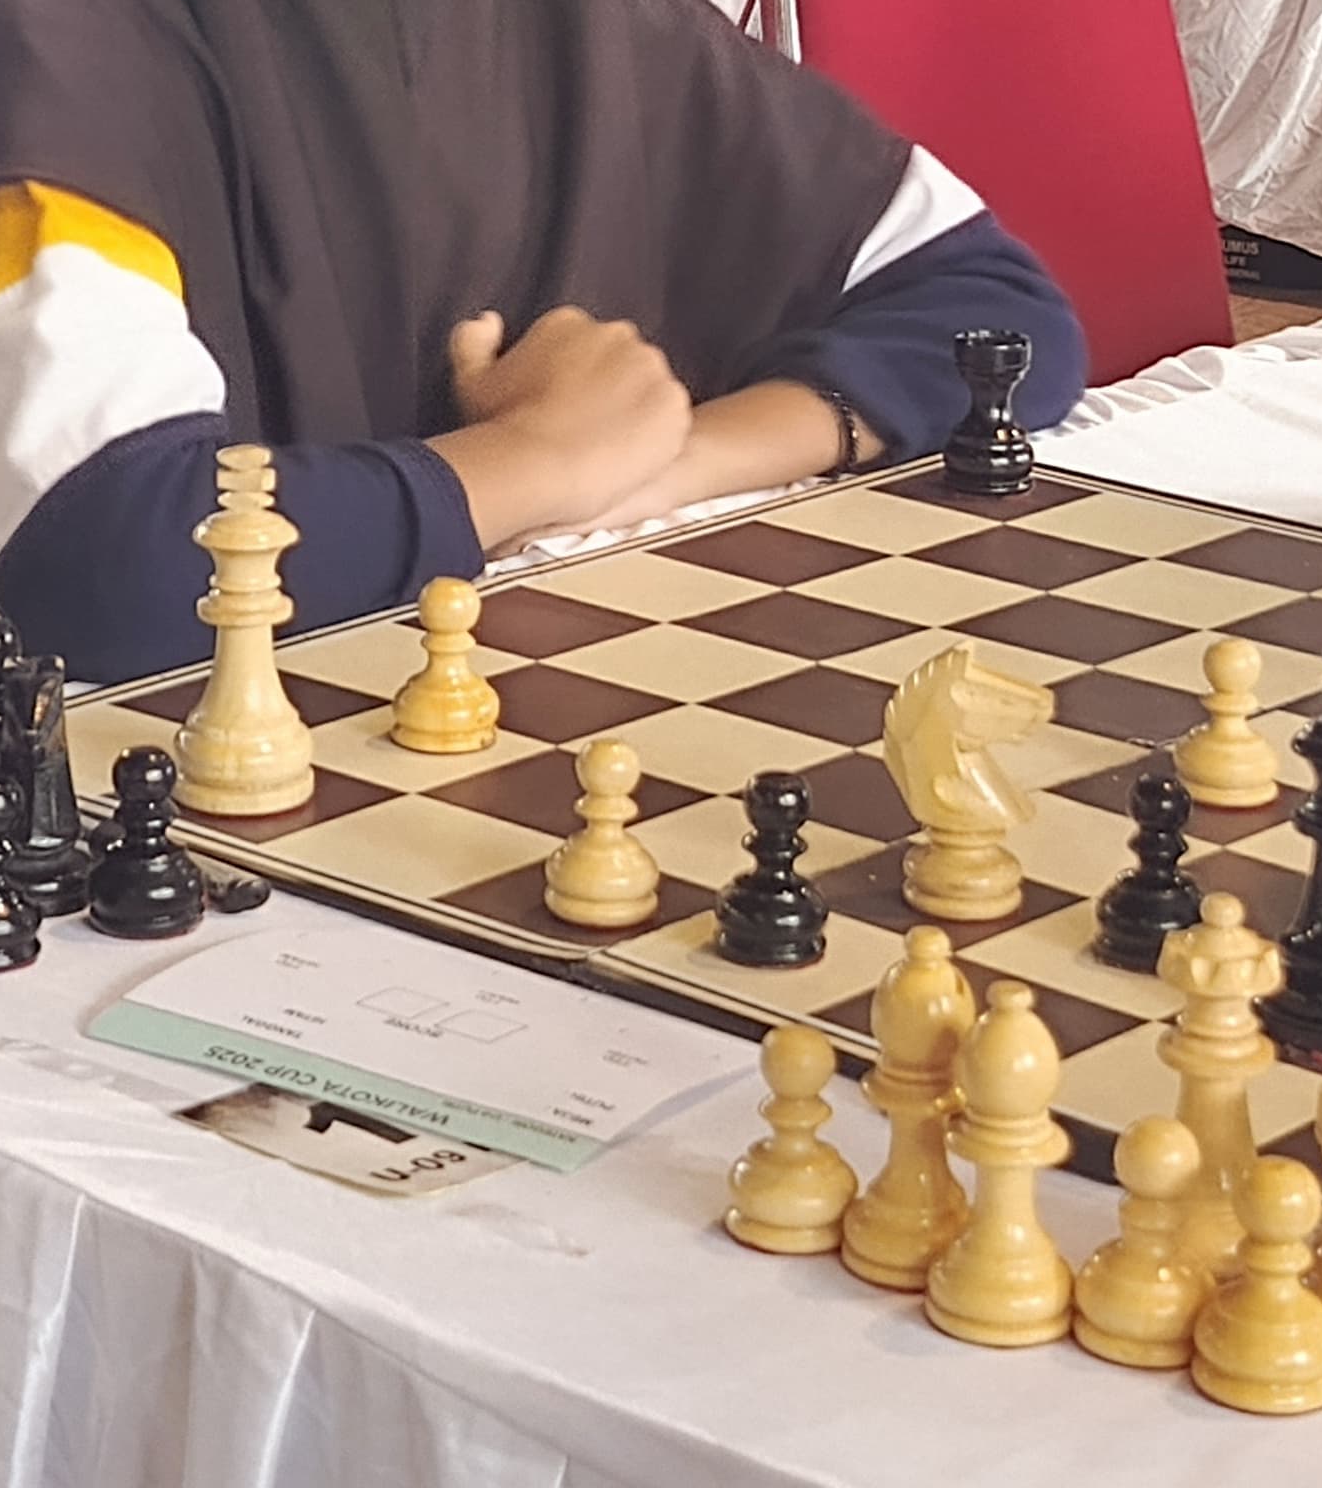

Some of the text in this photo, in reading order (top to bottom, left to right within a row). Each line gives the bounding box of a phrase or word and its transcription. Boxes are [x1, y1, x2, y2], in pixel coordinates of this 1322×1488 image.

[203, 1045, 263, 1070] 2025
[264, 1062, 317, 1086] CUP
[322, 1079, 451, 1127] WALIKOTA
